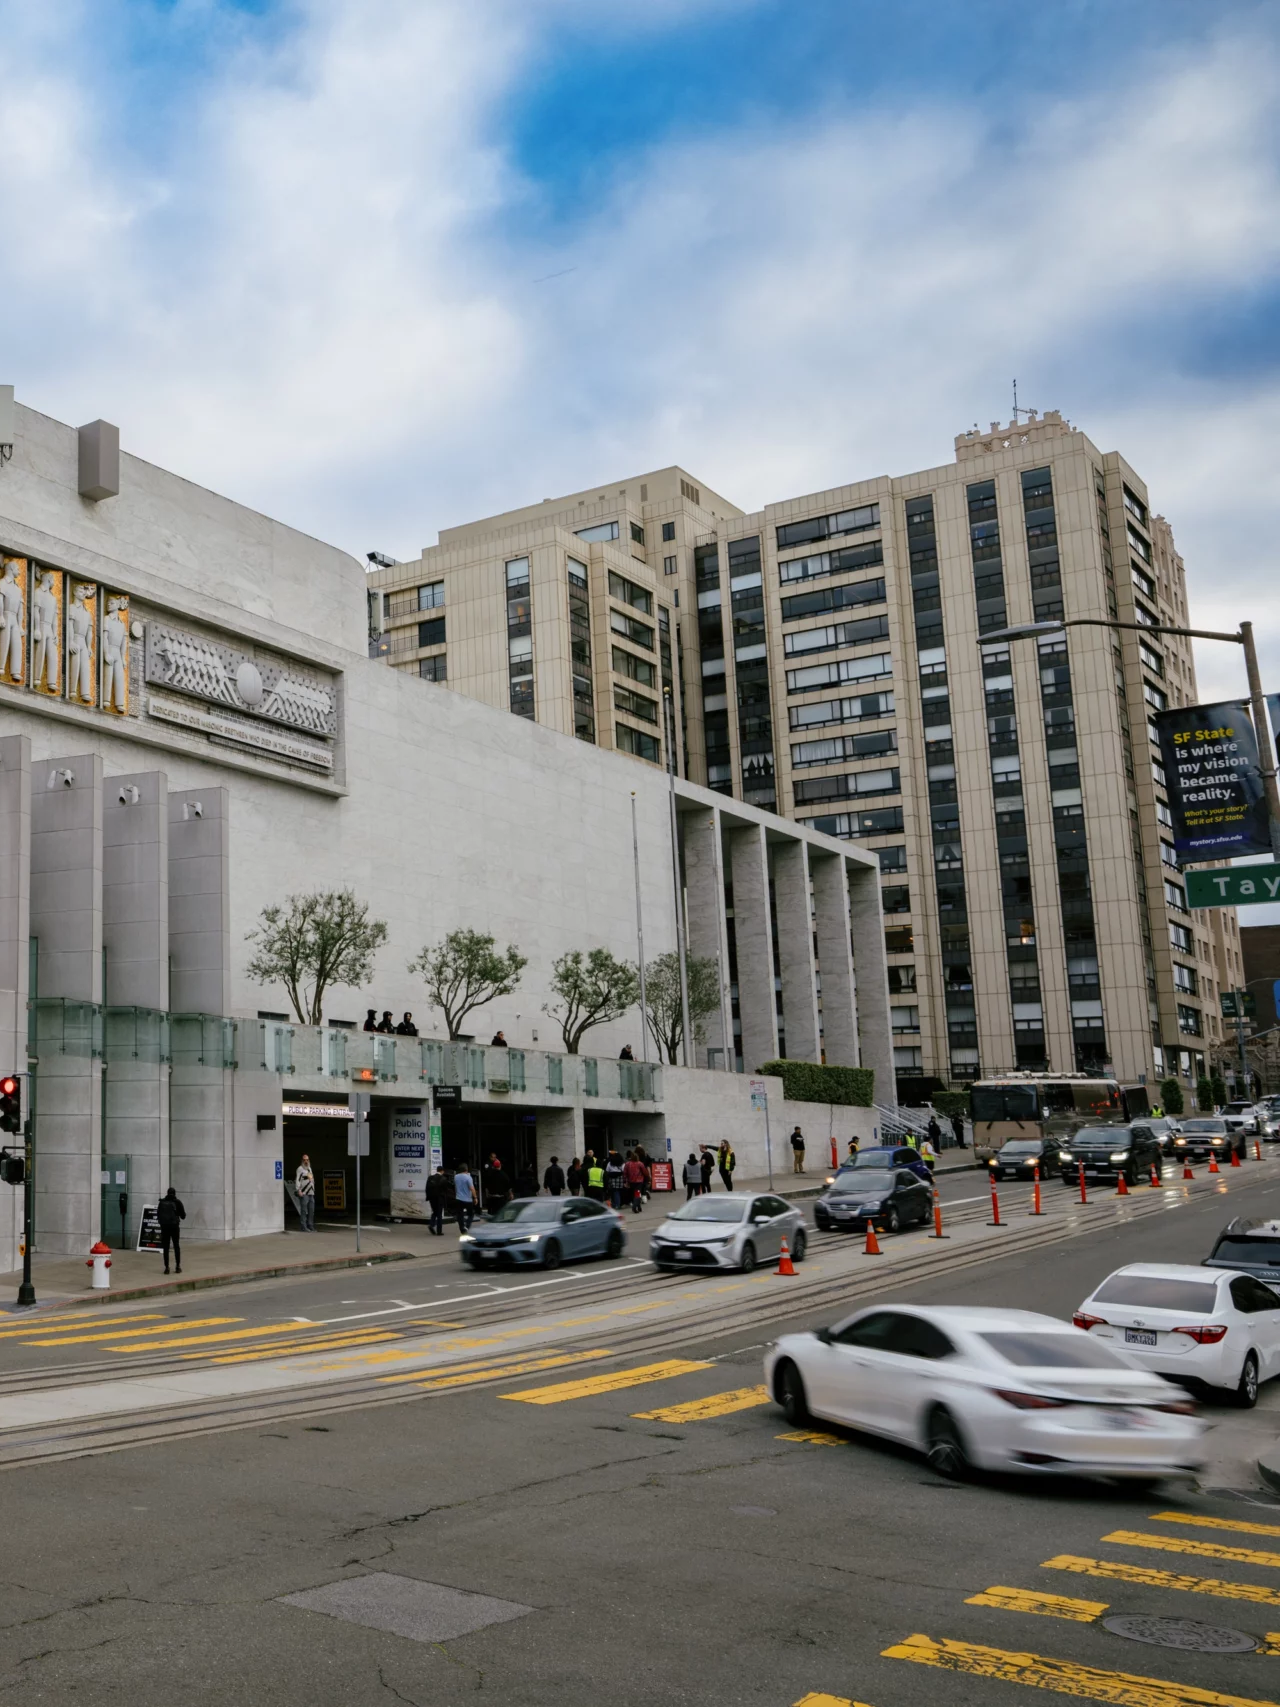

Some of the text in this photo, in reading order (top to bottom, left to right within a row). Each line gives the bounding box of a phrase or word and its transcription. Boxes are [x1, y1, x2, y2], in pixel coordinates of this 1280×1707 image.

[152, 704, 179, 719] DEDICATED
[180, 713, 188, 722] TO
[189, 716, 200, 726] OUR
[201, 720, 223, 733] MASONIC
[224, 726, 248, 740] BRETHREN
[248, 734, 260, 743] WHO
[261, 737, 272, 747] DIED
[278, 742, 287, 752] THE
[287, 745, 302, 756] CAUSE
[310, 752, 331, 764] FREEDOM
[1174, 727, 1235, 744] SF State
[1175, 742, 1238, 758] is where
[1178, 755, 1249, 775] my vision
[1180, 773, 1238, 787] became
[1182, 789, 1235, 804] reality.
[1184, 804, 1248, 817] What's your story?
[1224, 814, 1245, 822] State.
[1189, 834, 1243, 846] mystory.sfsu.edu
[1212, 876, 1280, 898] Tay
[288, 1106, 308, 1114] PUBLIC
[309, 1107, 332, 1116] PARKING
[395, 1119, 422, 1128] Public
[392, 1130, 425, 1141] Parking
